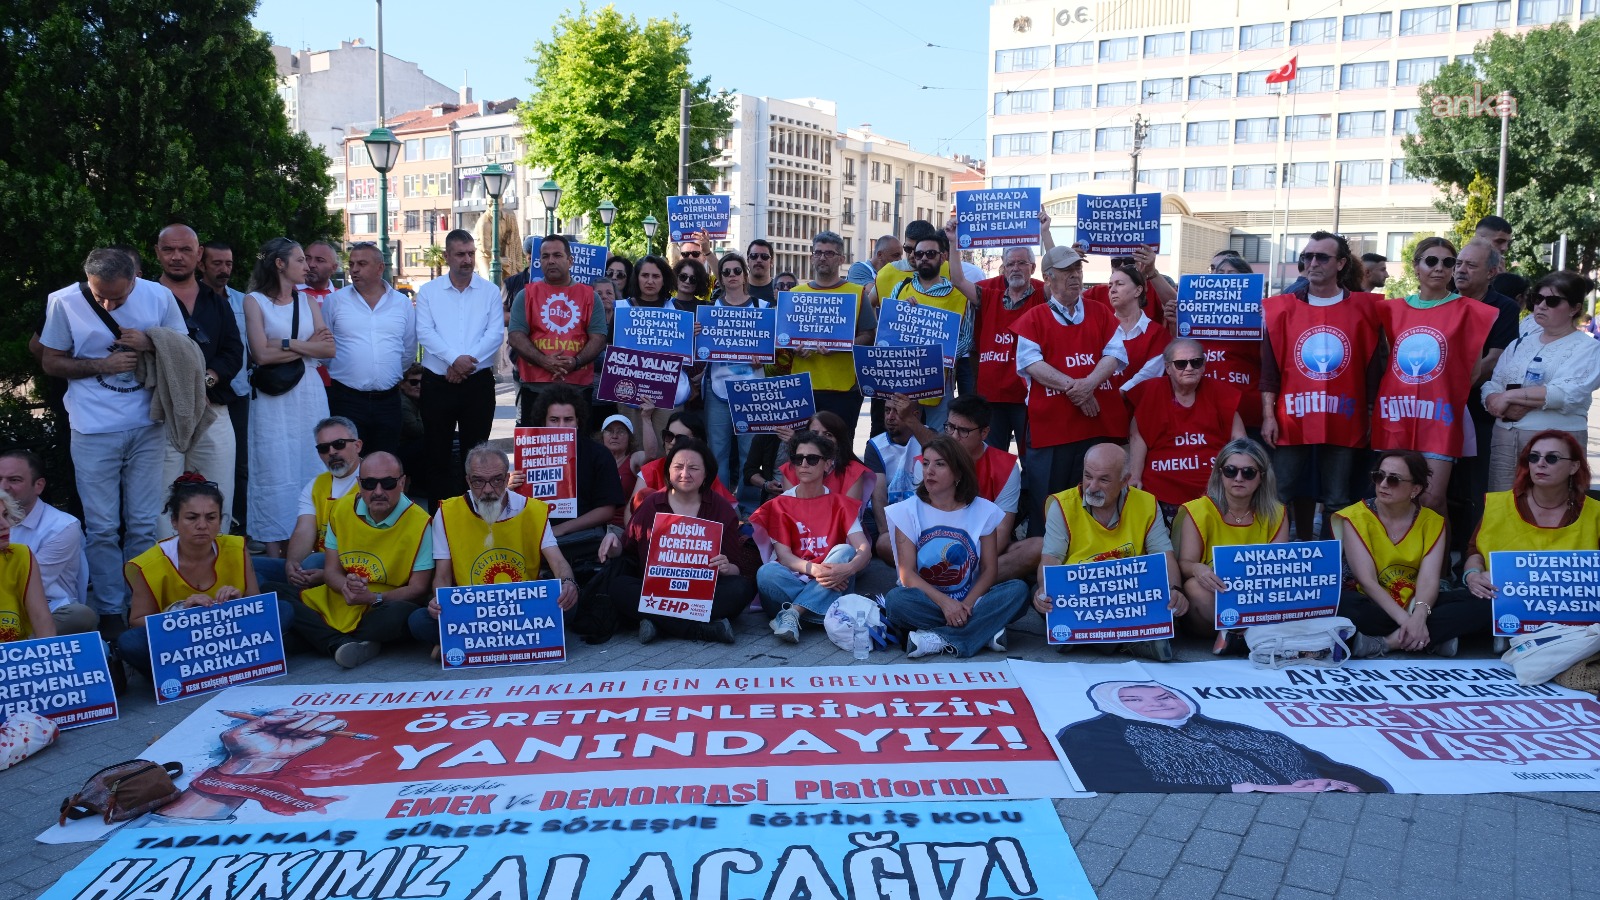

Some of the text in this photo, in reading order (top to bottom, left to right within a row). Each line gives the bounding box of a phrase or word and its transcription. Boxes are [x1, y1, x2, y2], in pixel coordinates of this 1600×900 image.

[677, 197, 722, 206] ANKARA'DA
[968, 190, 1029, 202] ANKARA'DA
[1086, 196, 1148, 209] MÜCADELE
[683, 204, 718, 213] DİRENEN
[975, 201, 1021, 211] DİRENEN
[670, 213, 728, 221] ÖĞRETMENLERE
[959, 210, 1038, 223] ÖĞRETMENLERE
[1092, 207, 1141, 220] DERSİNİ
[679, 220, 722, 229] BİN SELAM!
[969, 219, 1027, 233] BİN SELAM!
[1077, 218, 1159, 232] ÖĞRETMENLER
[1088, 230, 1145, 243] VERİYOR!
[1189, 276, 1250, 289] MÜCADELE
[791, 293, 843, 305] ÖĞRETMEN
[1195, 288, 1242, 300] DERSİNİ
[794, 304, 840, 315] DÜŞMANI
[895, 302, 949, 322] ÖĞRETMEN
[1178, 300, 1259, 313] ÖĞRETMENLER
[629, 308, 682, 321] ÖĞRETMEN
[710, 308, 763, 320] DÜZENİNİZ
[786, 314, 847, 324] YUSUF TEKİN
[897, 313, 944, 329] DÜŞMANI
[1190, 312, 1244, 325] VERİYOR!
[632, 317, 678, 329] DÜŞMANI
[717, 319, 756, 329] BATSIN!
[798, 323, 834, 334] İSTİFA!
[624, 327, 685, 340] YUSUF TEKİN
[701, 326, 771, 339] ÖĞRETMENLER
[888, 321, 950, 341] YUSUF TEKİN
[637, 335, 673, 347] İSTİFA!
[712, 337, 759, 348] YAŞASIN!
[867, 347, 928, 358] DÜZENİNİZ
[979, 350, 1010, 363] EMEKLİ
[608, 351, 680, 373] ASLA YALNIZ
[876, 358, 920, 368] BATSIN!
[1065, 352, 1095, 368] DİSK
[607, 365, 678, 384] YÜRÜMEYECEKSİN
[861, 365, 938, 378] ÖĞRETMENLER
[1228, 371, 1250, 385] SEN
[733, 377, 802, 393] ÖĞRETMENE
[873, 377, 926, 389] YAŞASIN!
[751, 389, 787, 402] DEĞİL
[733, 397, 809, 413] PATRONLARA
[746, 410, 799, 422] BARİKAT!
[515, 432, 574, 446] ÖĞRETMENLERE
[1174, 432, 1207, 446] DİSK
[521, 444, 568, 457] EMEKÇİLERE
[522, 456, 568, 468] EMEKLİLERE
[1151, 454, 1199, 472] EMEKLİ
[527, 468, 562, 482] HEMEN
[533, 483, 556, 496] ZAM
[670, 523, 706, 538] DÜŞÜK
[659, 535, 713, 552] ÜCRETLERE
[658, 550, 709, 566] MÜLAKATA
[1233, 546, 1323, 563] ANKARA'DA
[1515, 553, 1600, 568] DÜZENİNİ
[649, 565, 714, 580] GÜVENCESİZLİĞE
[1067, 559, 1148, 582] DÜZENİNİZ
[1245, 560, 1312, 577] DİRENEN
[1222, 574, 1337, 592] ÖĞRETMENLERE
[1529, 570, 1599, 582] BATSIN!
[670, 580, 688, 590] SON
[1079, 577, 1139, 595] BATSIN!
[450, 586, 548, 605] ÖĞRETMENE
[1055, 588, 1163, 608] ÖĞRETMENLER
[1237, 588, 1321, 605] BİN SELAM!
[476, 600, 525, 619] DEĞİL
[658, 598, 690, 614] EHP
[162, 601, 264, 632] ÖĞRETMENE
[1073, 604, 1147, 624] YAŞASIN!
[191, 619, 242, 643] DEĞİL
[447, 616, 556, 635] PATRONLARA
[160, 630, 275, 666] PATRONLARA
[464, 632, 540, 650] BARİKAT!
[0, 640, 82, 664] ÜCADELE
[180, 648, 260, 678] BARİKAT!
[1285, 667, 1384, 687] AYŞEN
[0, 670, 107, 700] RETMENLER
[291, 670, 1008, 707] ÖĞRETMENLER HAKLARI İÇİN AÇLIK GREVİNDELER!
[1386, 682, 1564, 702] TOPLASIN!
[77, 706, 113, 722] PLATFORMU
[404, 697, 1016, 733] ÖĞRETMENLERİMİZİN
[1274, 701, 1600, 730] ÖĞRETMENLİK
[393, 725, 1029, 771] YANINDAYIZ!
[1511, 771, 1596, 780] ÖĞRETMEN
[398, 779, 508, 797] Eskişehir
[385, 793, 498, 819] EMEK
[539, 778, 769, 812] DEMOKRASİ
[794, 777, 1010, 801] Platformu
[134, 809, 1024, 849] TABAN MAAŞ SÜRESİZ SÖZLEŞME EĞİTİM İŞ KOLU
[72, 844, 469, 900] HAKKIMIZ
